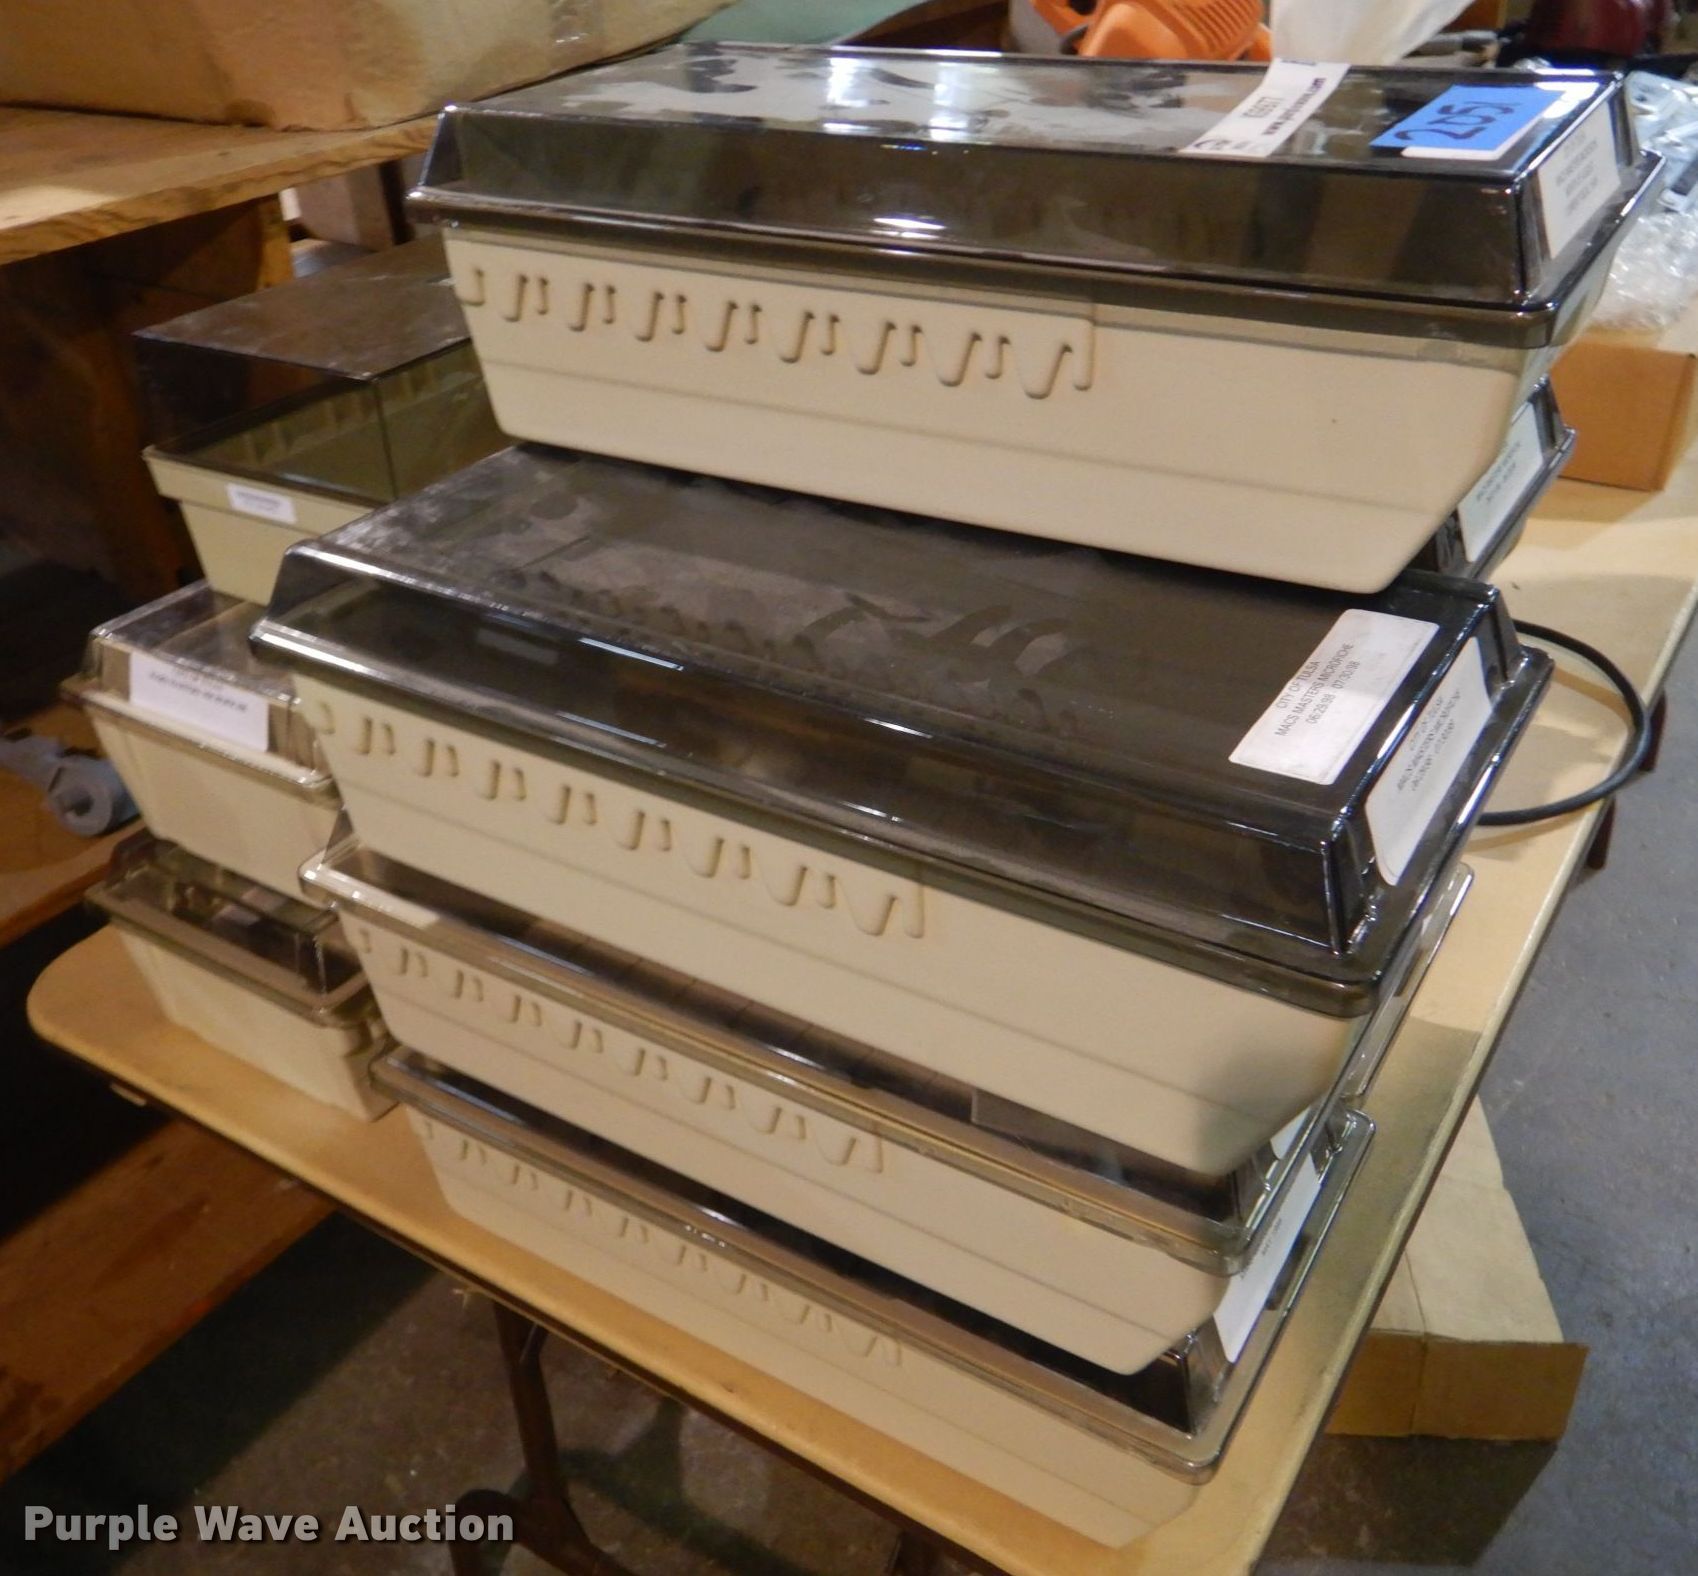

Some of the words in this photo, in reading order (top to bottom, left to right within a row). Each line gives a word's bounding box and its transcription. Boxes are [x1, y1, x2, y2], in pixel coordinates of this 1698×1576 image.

[1274, 714, 1300, 736] MACS
[1292, 681, 1324, 714] MASTERS
[1317, 643, 1354, 681] MICROFICHE
[1275, 693, 1295, 709] CITY
[1288, 681, 1301, 693] OF
[1296, 661, 1320, 681] TULSA
